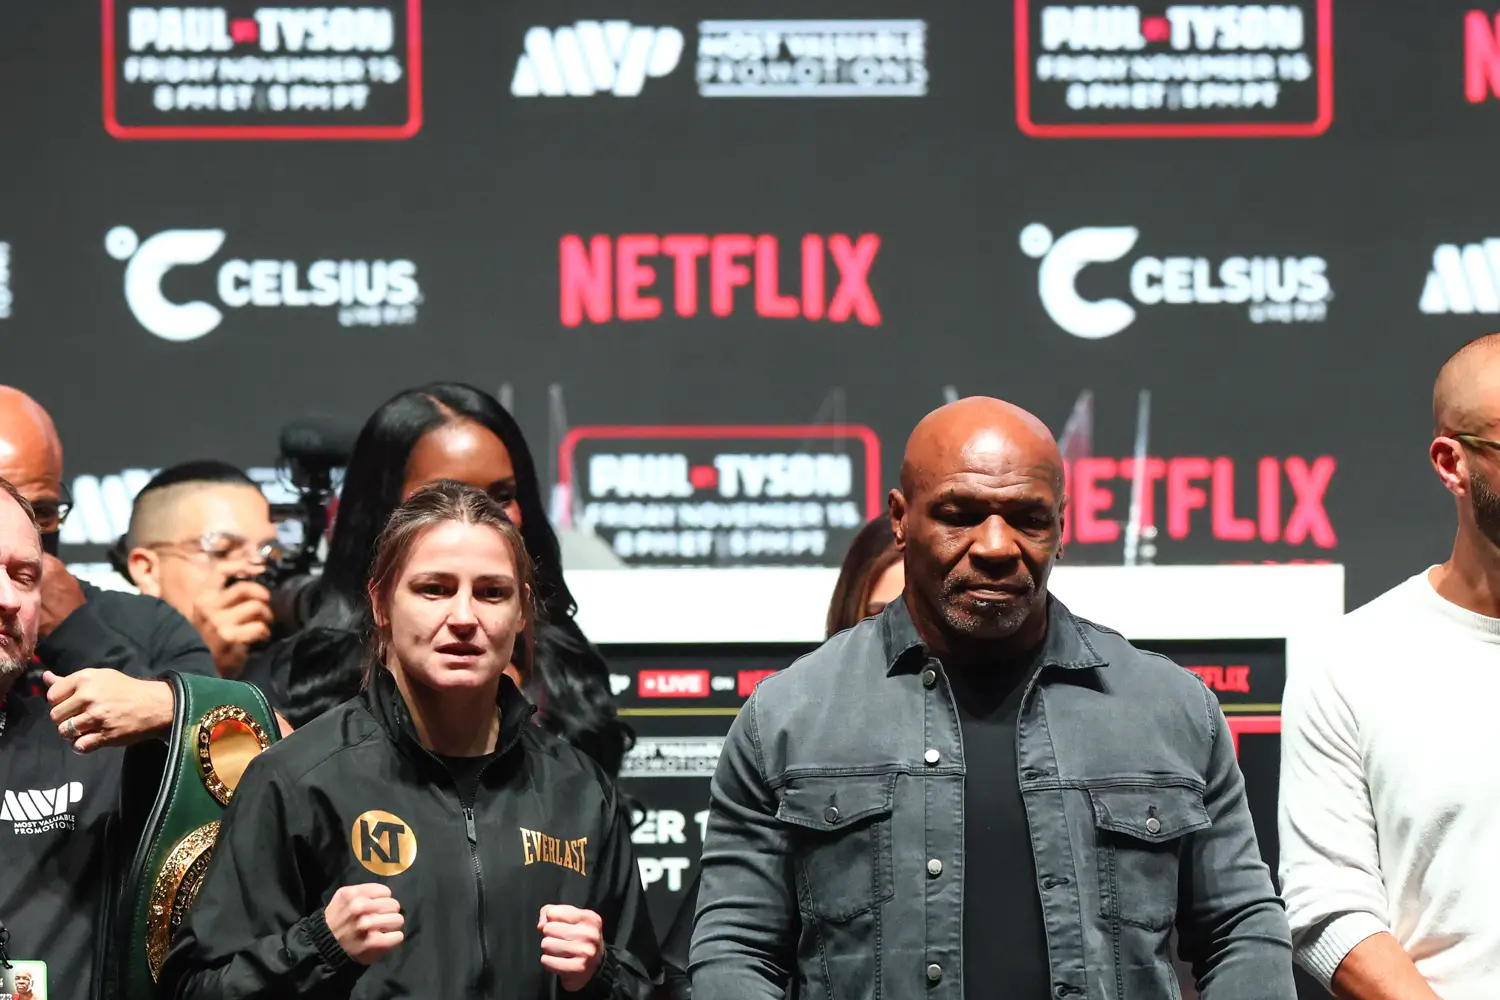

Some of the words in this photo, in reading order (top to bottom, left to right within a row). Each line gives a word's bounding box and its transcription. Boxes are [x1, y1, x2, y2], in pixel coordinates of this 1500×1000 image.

[129, 8, 233, 51] PAUL
[254, 8, 393, 51] TYSON
[1042, 6, 1146, 50] PAUL
[1166, 5, 1303, 50] TYSON
[511, 21, 684, 96] MVP
[217, 259, 419, 306] CELSIUS
[559, 234, 882, 327] NETFLIX
[1130, 256, 1329, 304] CELSIUS
[589, 454, 693, 497] PAUL
[714, 454, 852, 497] TYSON
[1062, 456, 1338, 548] ETFLIX
[657, 673, 703, 693] LIVE
[1186, 665, 1250, 693] FLIX
[0, 781, 84, 821] MVP
[13, 821, 38, 829] MOST
[38, 814, 76, 827] VALUABLE
[14, 821, 75, 835] PROMOTIONS
[359, 818, 405, 863] KT
[519, 826, 588, 877] EVERLAST
[637, 857, 691, 892] PT
